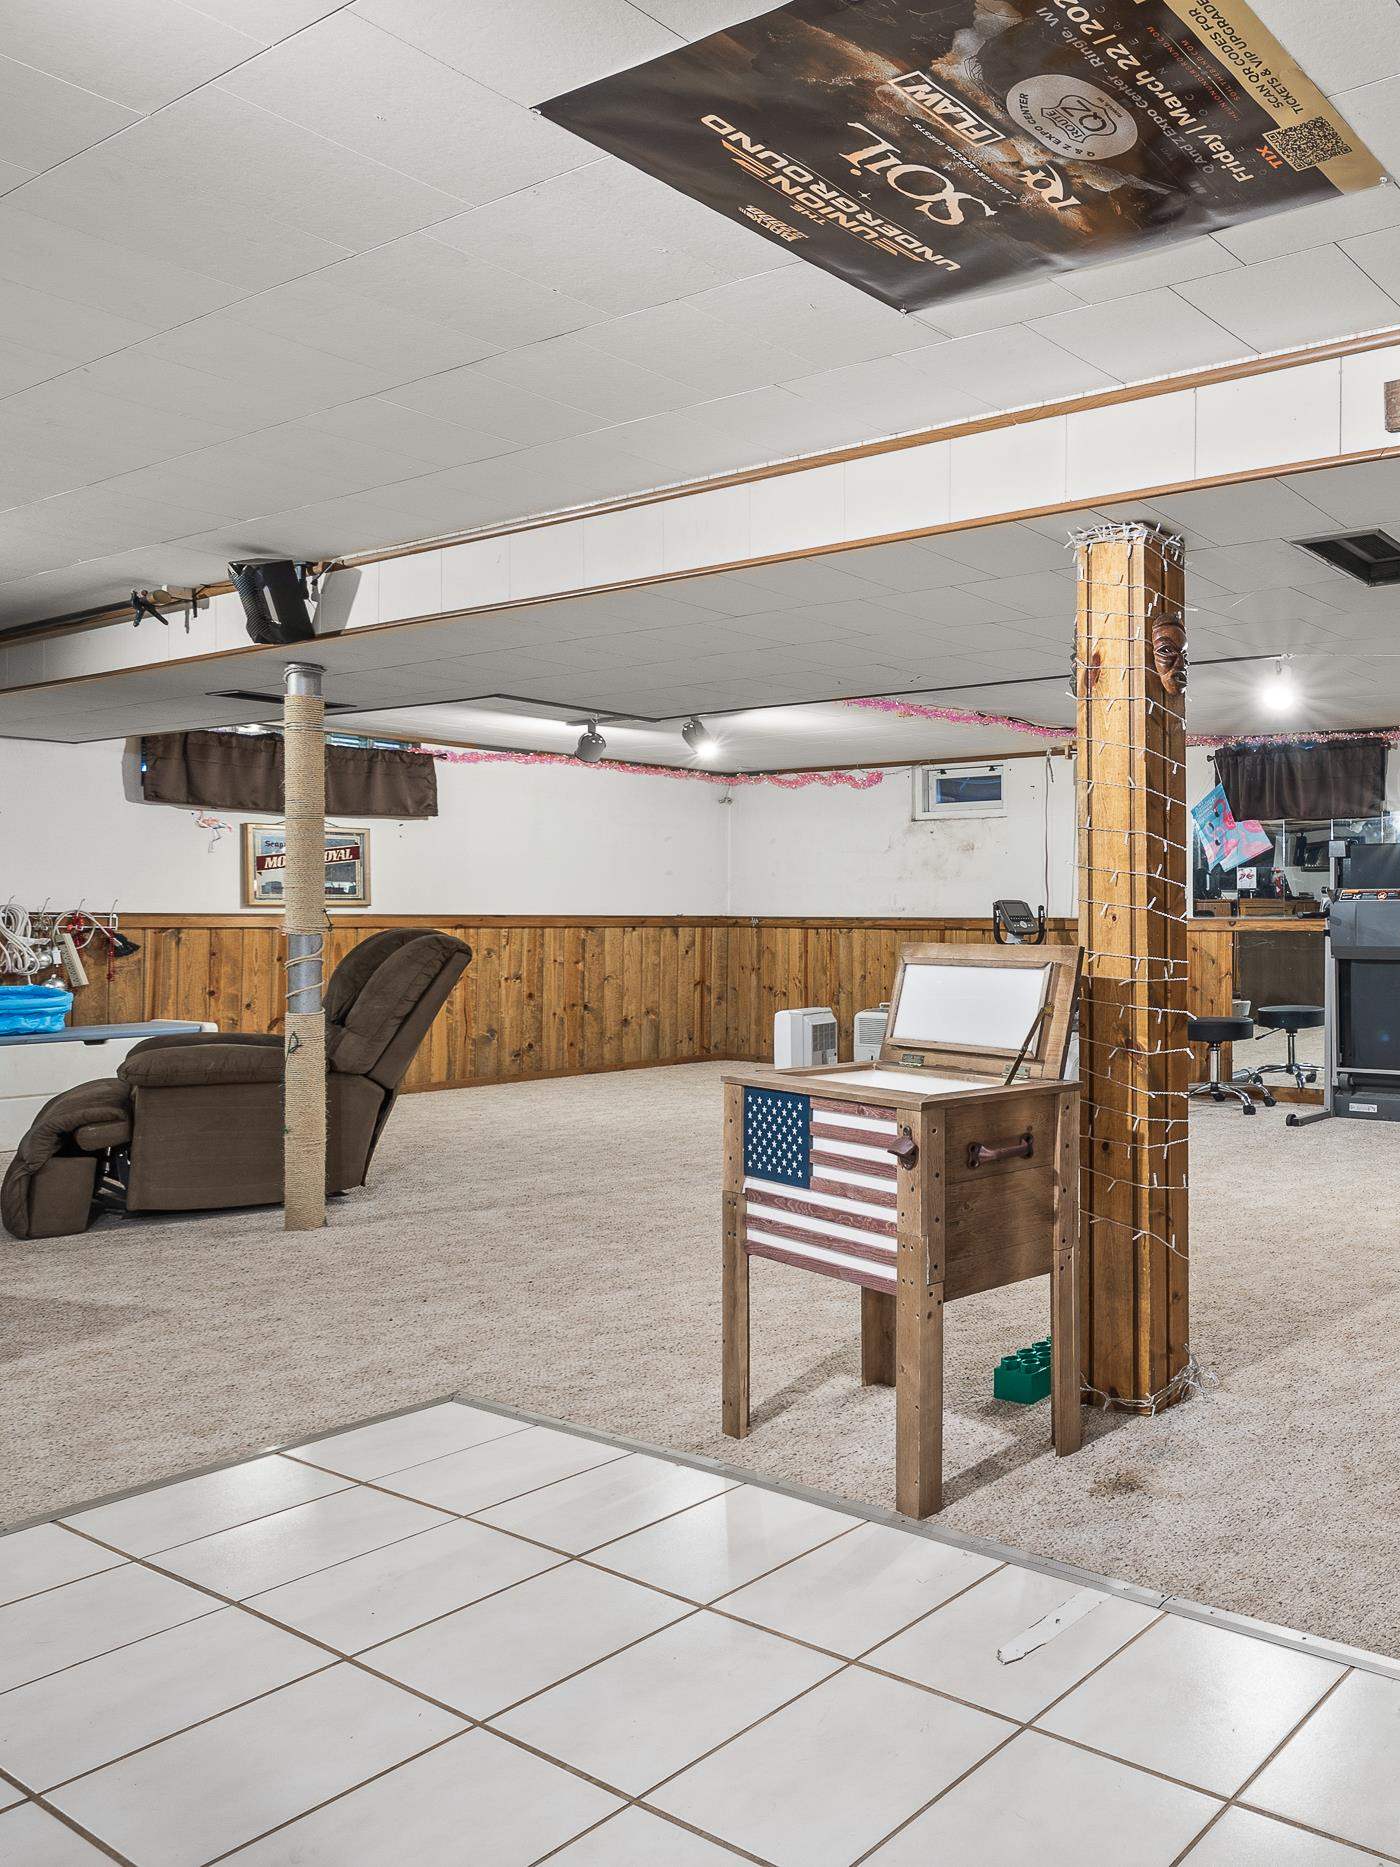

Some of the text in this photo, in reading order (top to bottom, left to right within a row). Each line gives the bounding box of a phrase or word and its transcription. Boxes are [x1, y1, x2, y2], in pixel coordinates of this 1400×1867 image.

[1034, 6, 1061, 25] WI
[1050, 0, 1108, 38] 202
[1195, 0, 1249, 48] UPGRADE
[1054, 25, 1108, 67] Ringle,
[1103, 43, 1142, 70] 22
[1187, 7, 1283, 108] SCAN QR CODES FOR
[1242, 50, 1265, 67] VIP
[1106, 74, 1150, 108] Center
[1128, 69, 1200, 125] March
[1266, 76, 1305, 113] TICKETS
[901, 79, 993, 140] FLAW
[1020, 93, 1035, 124] CENTER
[1044, 109, 1084, 138] ROUTE
[1060, 100, 1107, 131] QZ
[1141, 107, 1180, 136] Expo
[1033, 125, 1061, 144] EXPO
[1178, 143, 1209, 165] And
[1191, 130, 1260, 181] Friday
[1254, 144, 1286, 168] TIX
[695, 112, 962, 272] UNDERGROUND
[766, 174, 881, 240] UNION
[788, 203, 829, 225] THE
[324, 848, 353, 863] OYAL
